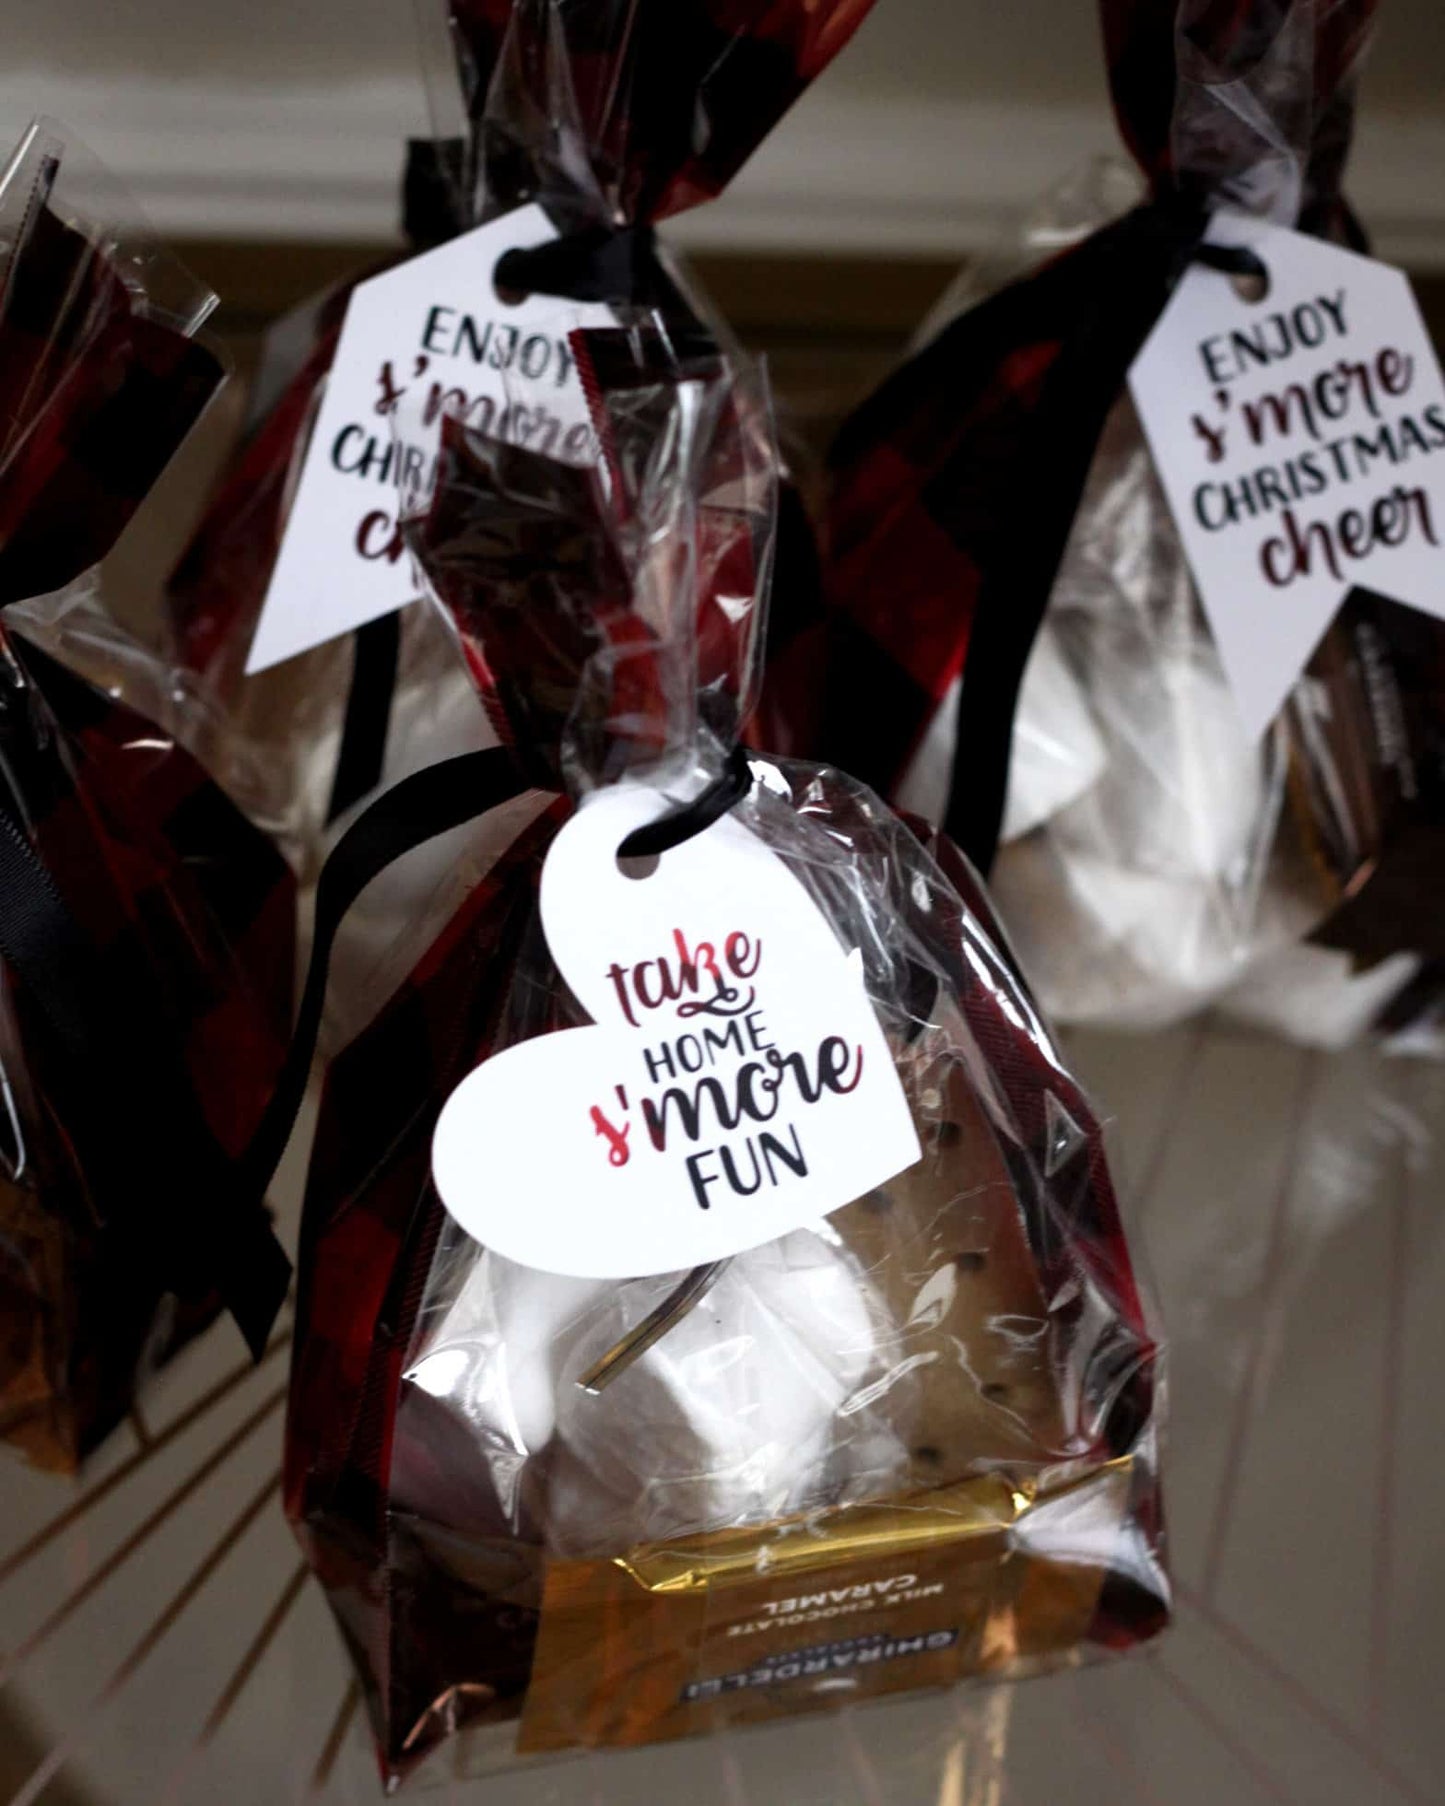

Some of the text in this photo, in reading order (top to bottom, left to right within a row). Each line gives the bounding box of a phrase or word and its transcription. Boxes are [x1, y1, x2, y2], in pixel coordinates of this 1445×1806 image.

[421, 305, 575, 388] ENJOY
[1198, 287, 1346, 384] ENJOY
[1190, 348, 1413, 463] s'more
[1193, 403, 1445, 532] CHRISTMAS
[1260, 485, 1440, 588] cheer
[605, 927, 762, 1028] take
[643, 1009, 776, 1084] HOME
[589, 1035, 864, 1167] s'more
[685, 1123, 808, 1210] FUN
[725, 1583, 945, 1637] MILK CHOCOLATE
[760, 1573, 918, 1616] CARAMEL
